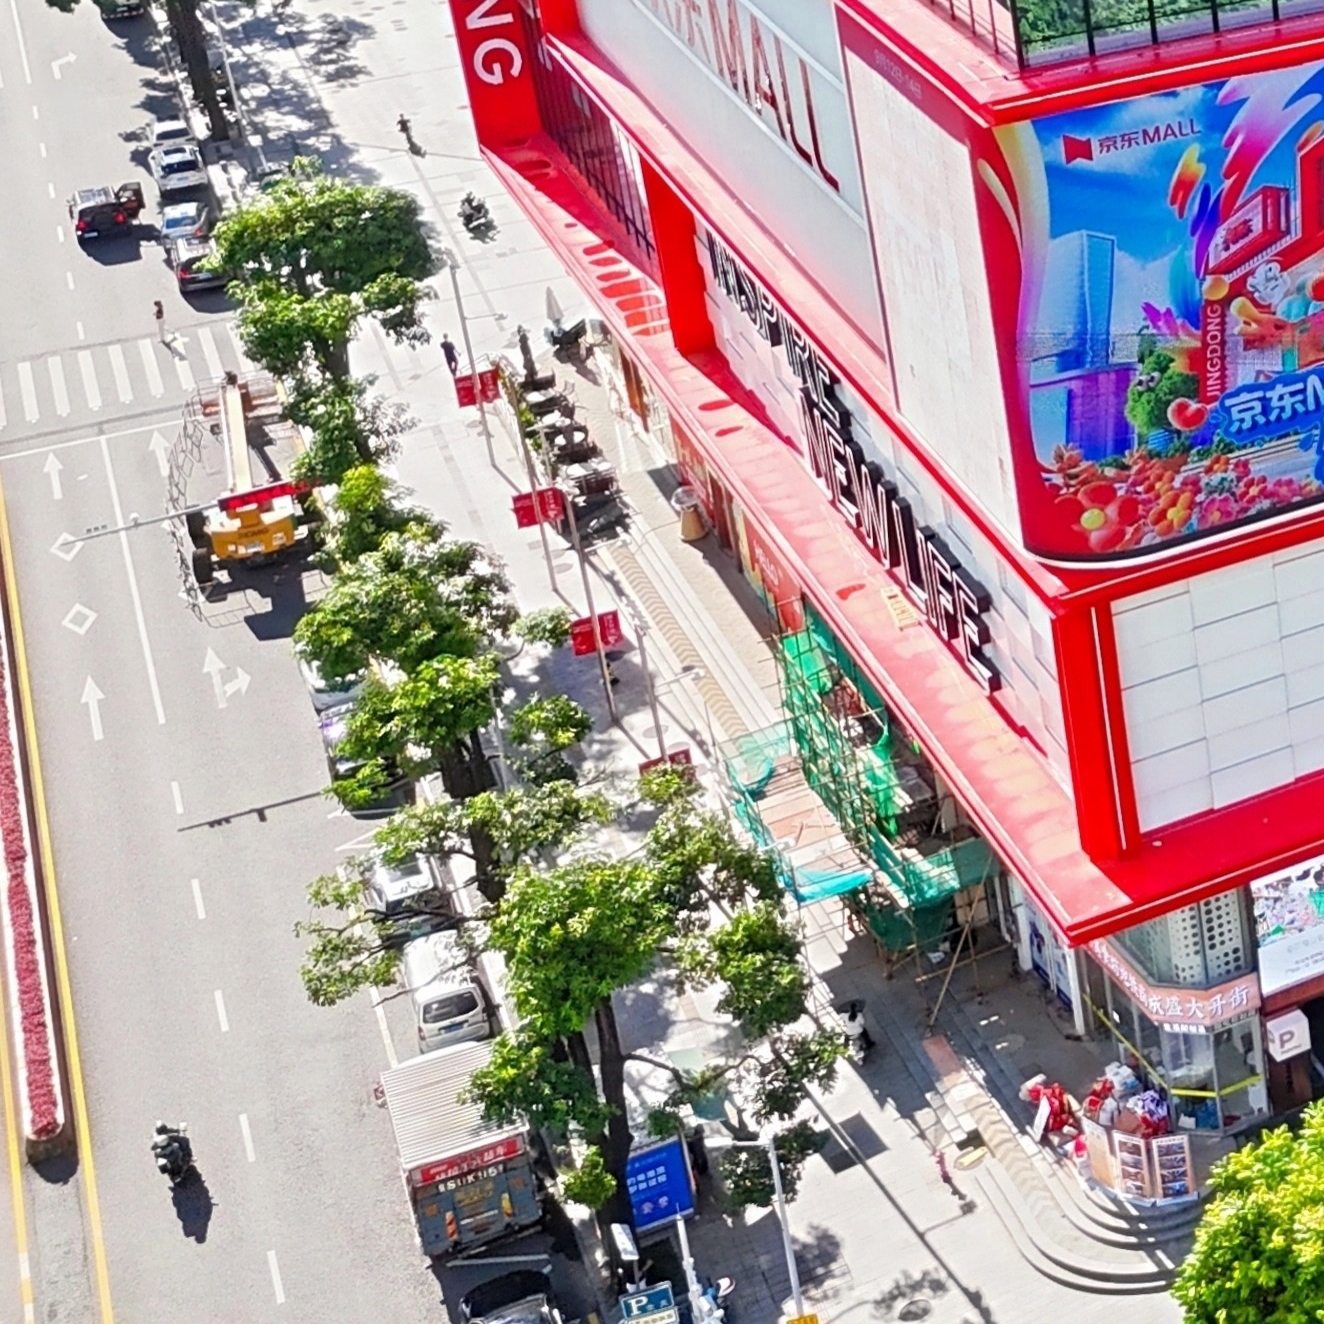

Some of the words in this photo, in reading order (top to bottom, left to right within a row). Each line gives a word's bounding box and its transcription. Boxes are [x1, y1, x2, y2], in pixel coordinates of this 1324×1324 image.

[1097, 118, 1202, 155] 京东MALL
[1206, 304, 1222, 397] JINGDONG
[797, 386, 900, 571] NEW
[891, 497, 1003, 695] LIFE
[1279, 1029, 1296, 1050] P
[627, 1295, 650, 1317] P
